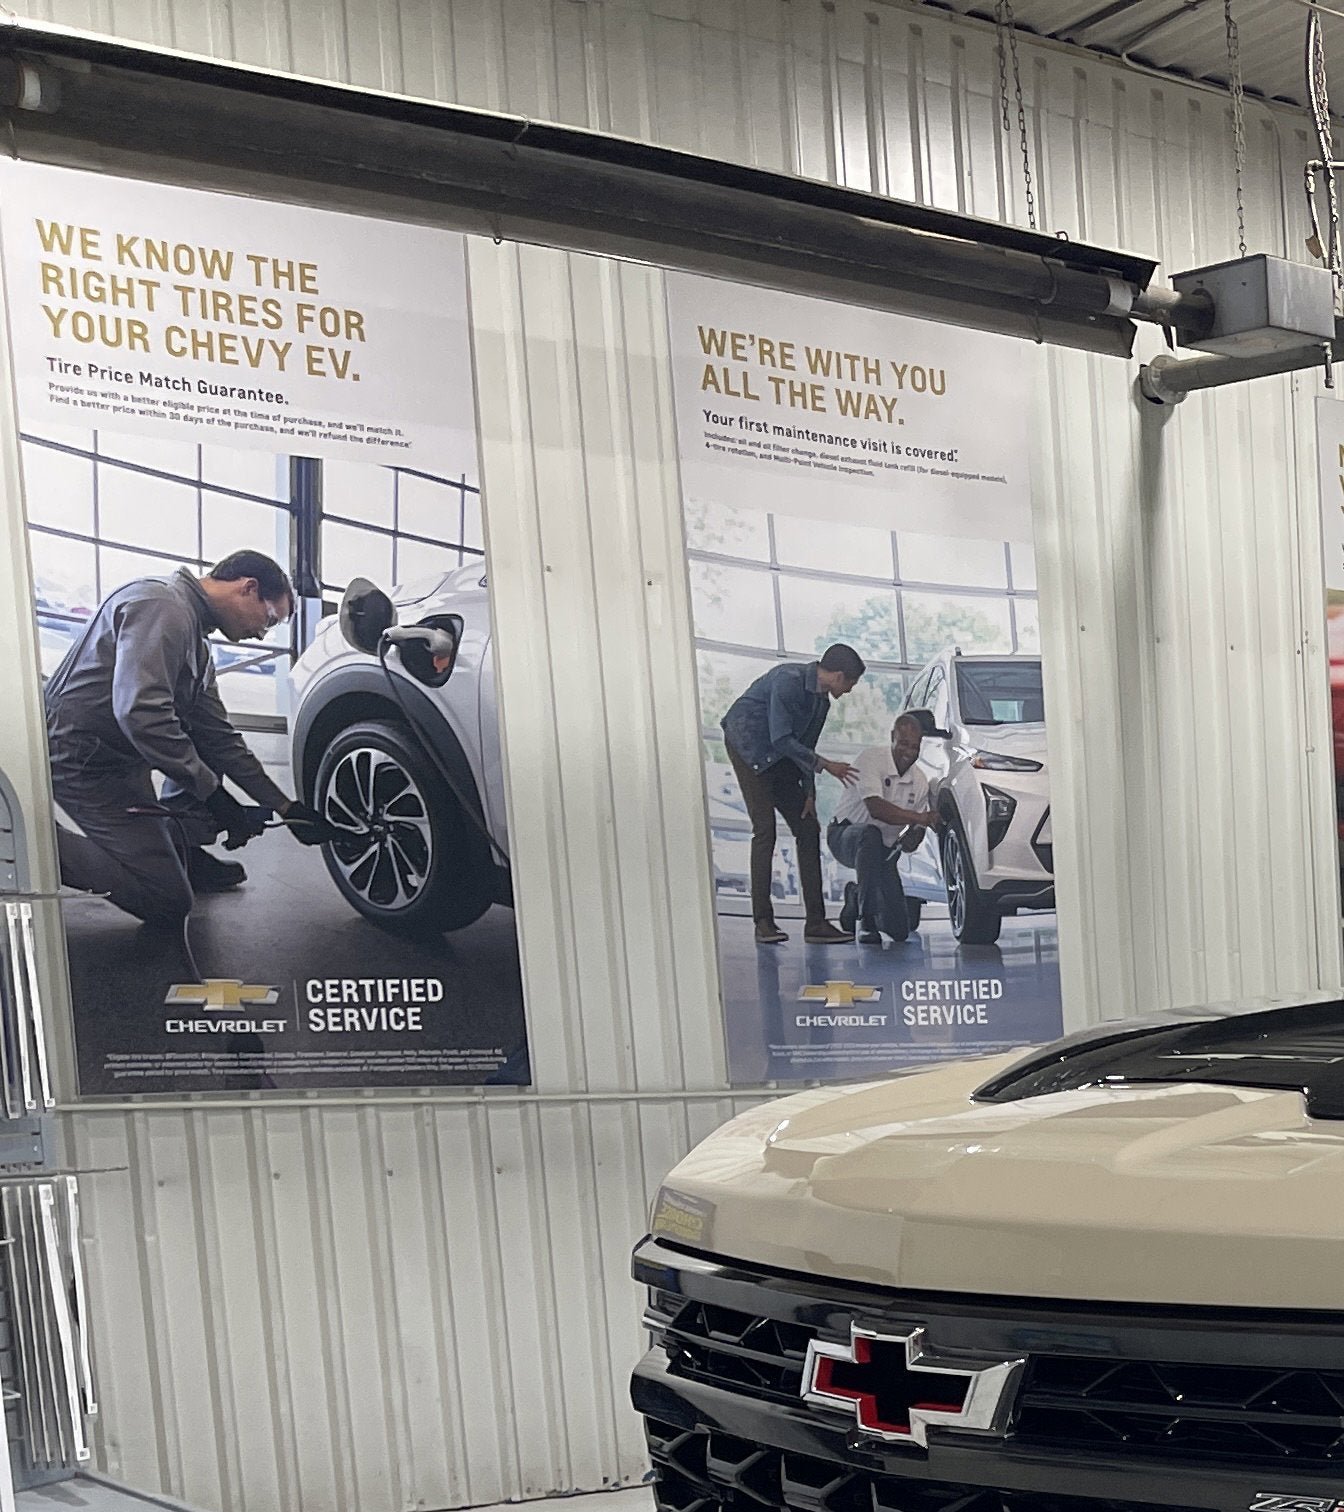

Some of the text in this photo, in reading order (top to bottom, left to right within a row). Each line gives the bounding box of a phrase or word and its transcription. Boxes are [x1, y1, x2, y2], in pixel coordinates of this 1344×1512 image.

[35, 219, 319, 295] WE KNOW THE
[40, 262, 366, 341] RIGHT TIRES FOR
[42, 305, 361, 381] YOUR CHEVY EV.
[697, 325, 946, 395] WE'RE WITH YOU
[46, 357, 289, 405] Tire Price Match Guarantee.
[701, 364, 904, 425] ALL THE WAY.
[49, 382, 84, 395] Provide
[101, 391, 120, 400] with
[197, 405, 219, 414] price
[234, 409, 247, 418] the
[250, 411, 269, 420] time
[113, 405, 135, 414] price
[183, 414, 203, 425] days
[206, 417, 215, 425] of
[217, 419, 231, 427] the
[280, 427, 294, 435] and
[702, 409, 735, 427] Your
[738, 415, 769, 434] first
[772, 425, 858, 449] maintenance
[860, 437, 888, 453] visit
[891, 441, 902, 455] is
[305, 978, 443, 1003] CERTIFIED
[902, 978, 1002, 1001] CERTIFIED
[165, 1019, 287, 1033] CHEVROLET
[308, 1007, 423, 1032] SERVICE
[796, 1015, 887, 1027] CHEVROLET
[903, 1004, 988, 1026] SERVICE
